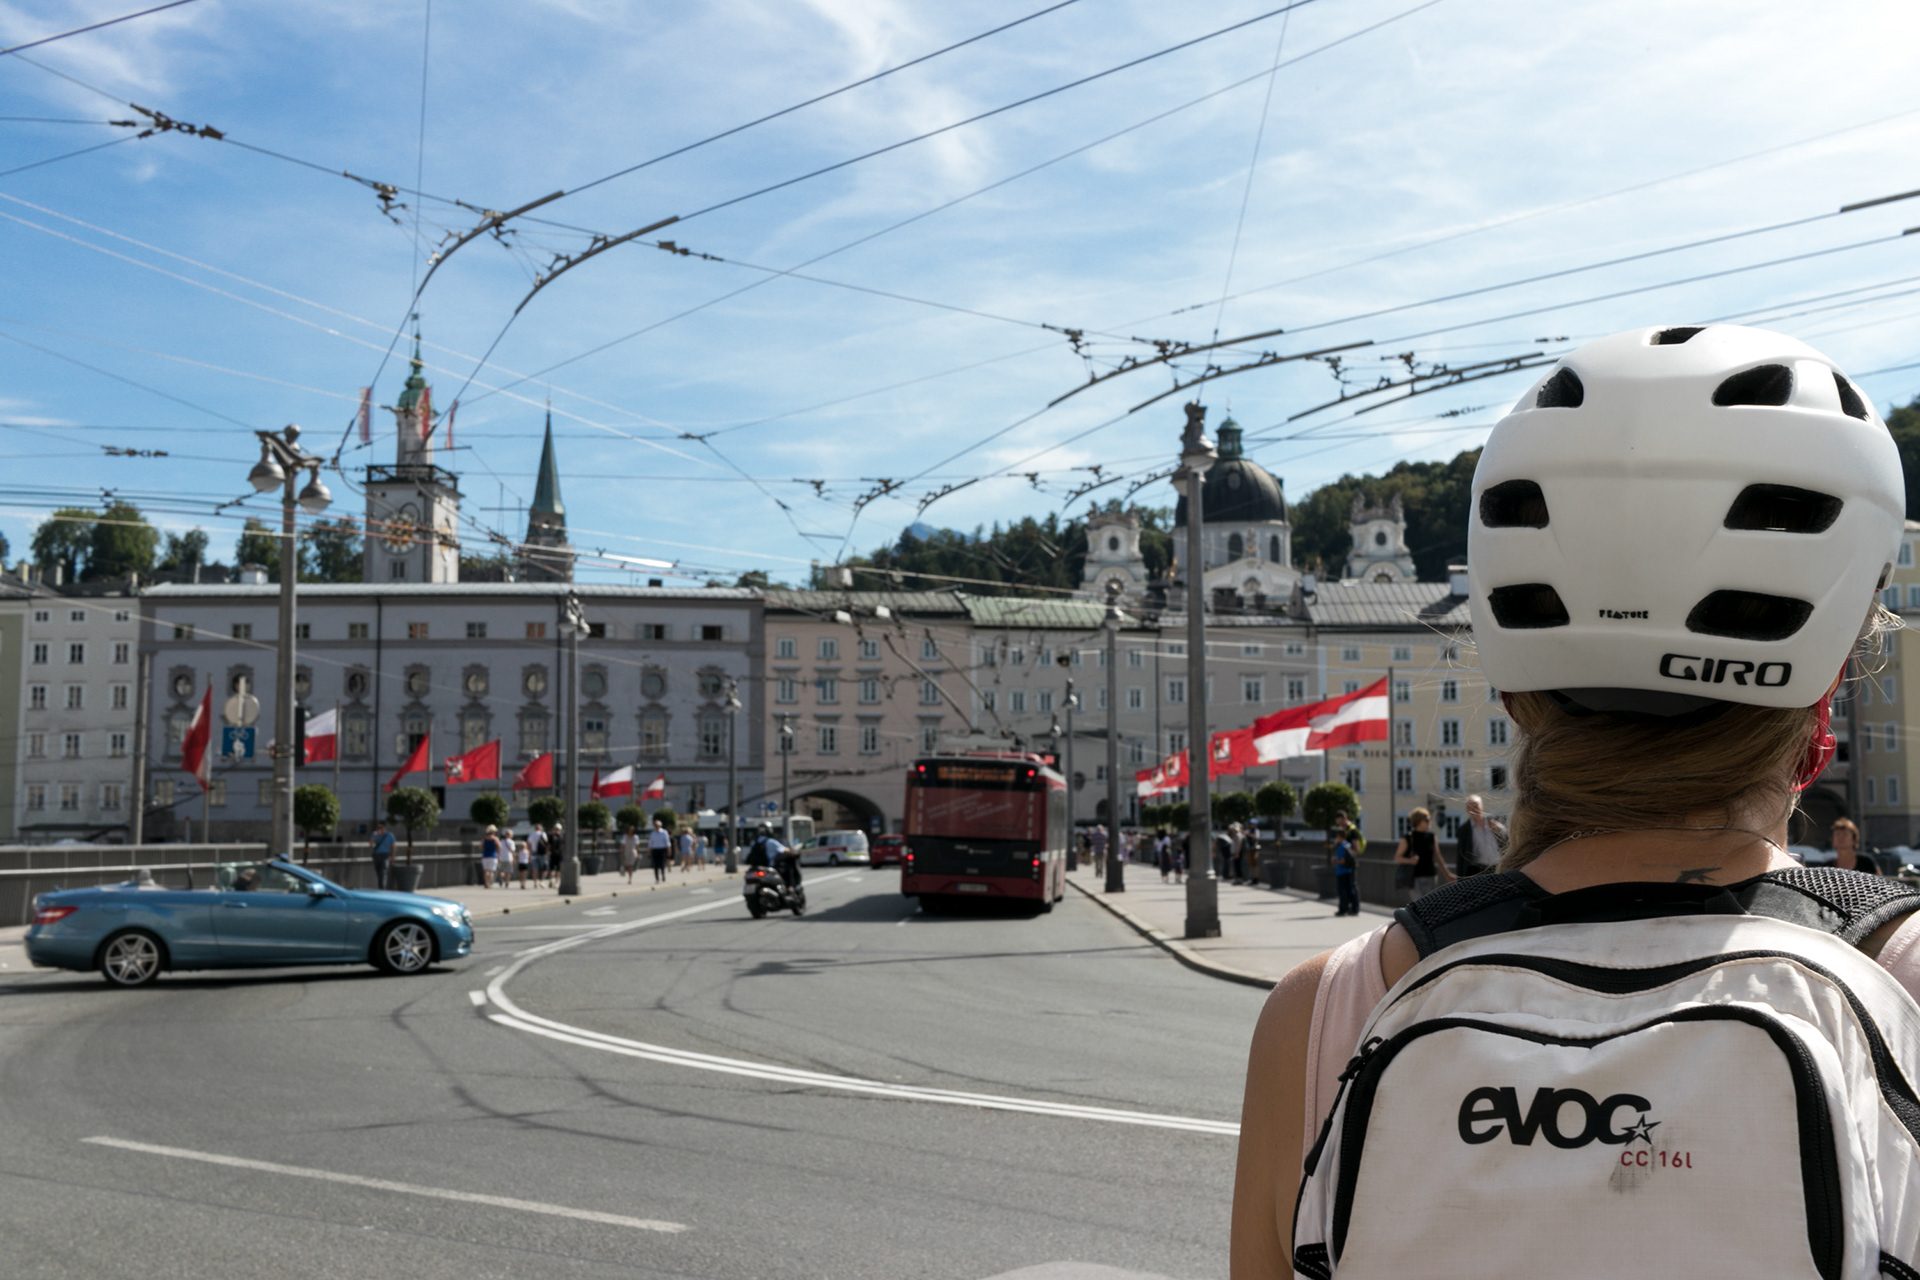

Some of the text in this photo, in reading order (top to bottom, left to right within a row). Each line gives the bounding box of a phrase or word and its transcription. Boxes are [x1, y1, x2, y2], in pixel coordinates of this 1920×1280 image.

[1599, 609, 1649, 619] FEATURE
[1659, 653, 1792, 686] GIRO
[1620, 1151, 1648, 1167] CC
